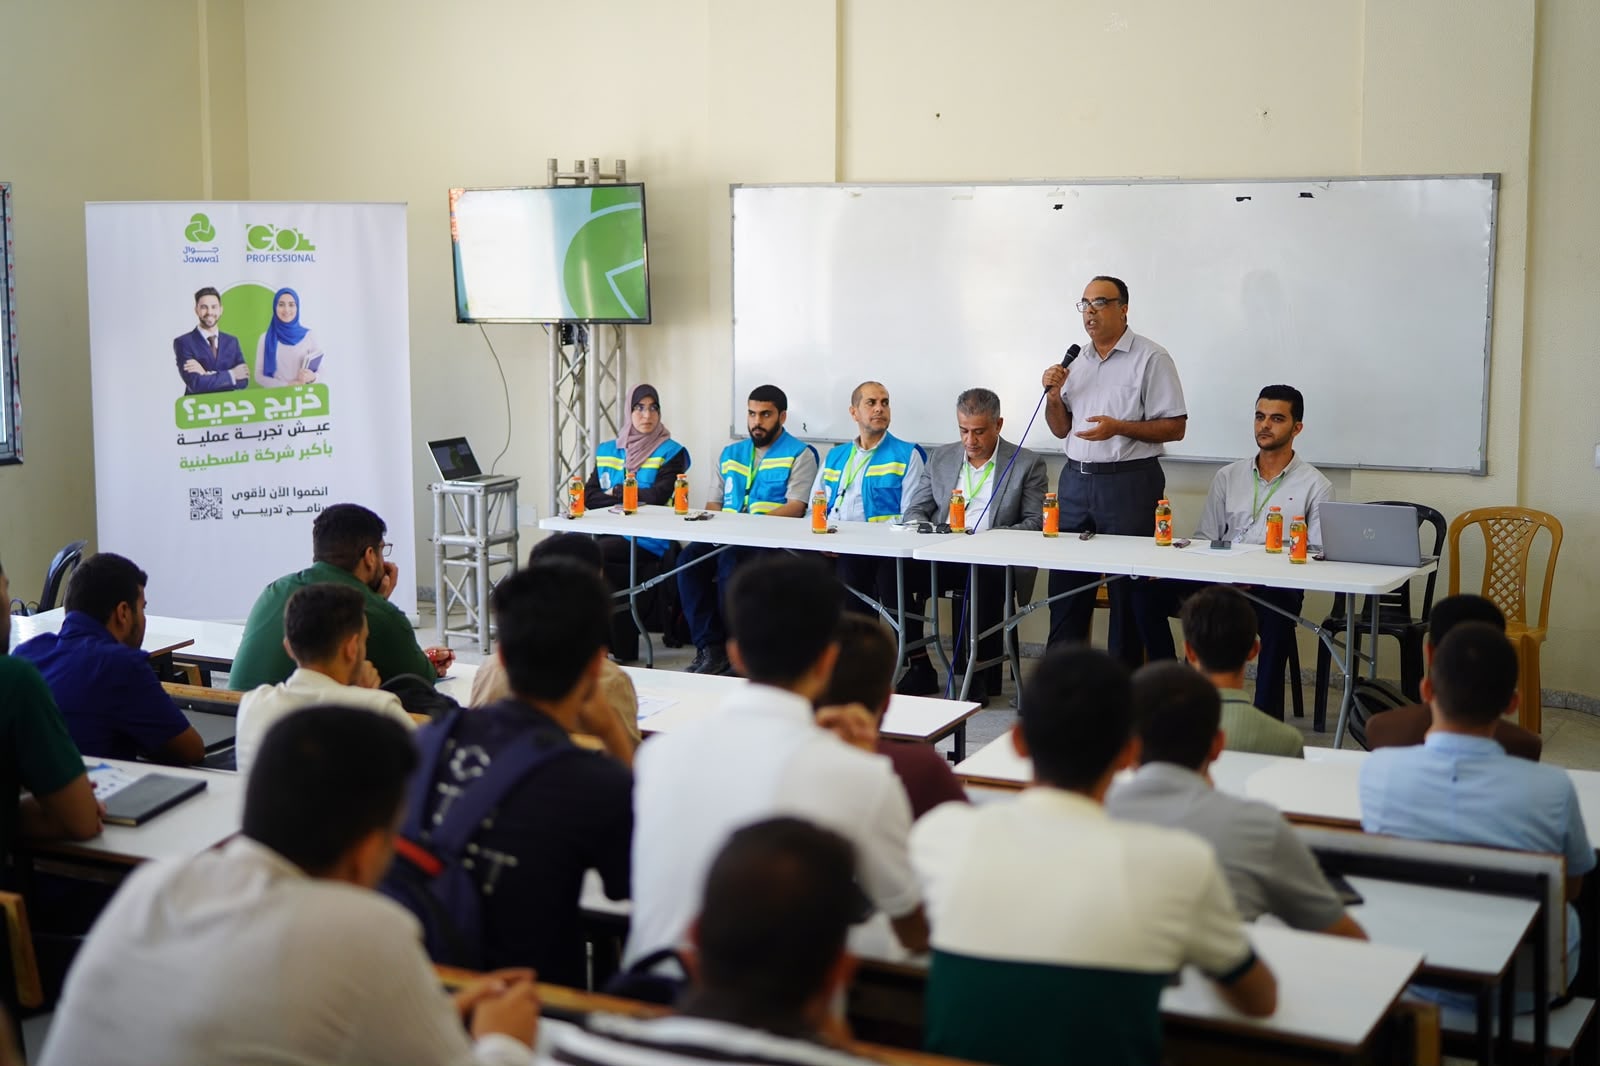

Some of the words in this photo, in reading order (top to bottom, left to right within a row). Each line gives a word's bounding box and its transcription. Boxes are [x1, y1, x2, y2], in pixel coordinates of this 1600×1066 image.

[183, 254, 219, 263] Jawwal
[246, 254, 316, 262] PROFESSIONAL
[183, 398, 256, 425] جديد؟
[235, 424, 283, 441] تجربة
[288, 420, 330, 437] عيش
[177, 431, 230, 448] عملية
[255, 444, 295, 463] شركة
[299, 439, 333, 461] بأكبر
[179, 450, 249, 472] فلسطينية
[232, 486, 266, 501] لأقوى
[293, 486, 328, 499] انضموا
[232, 504, 284, 519] تدريبي
